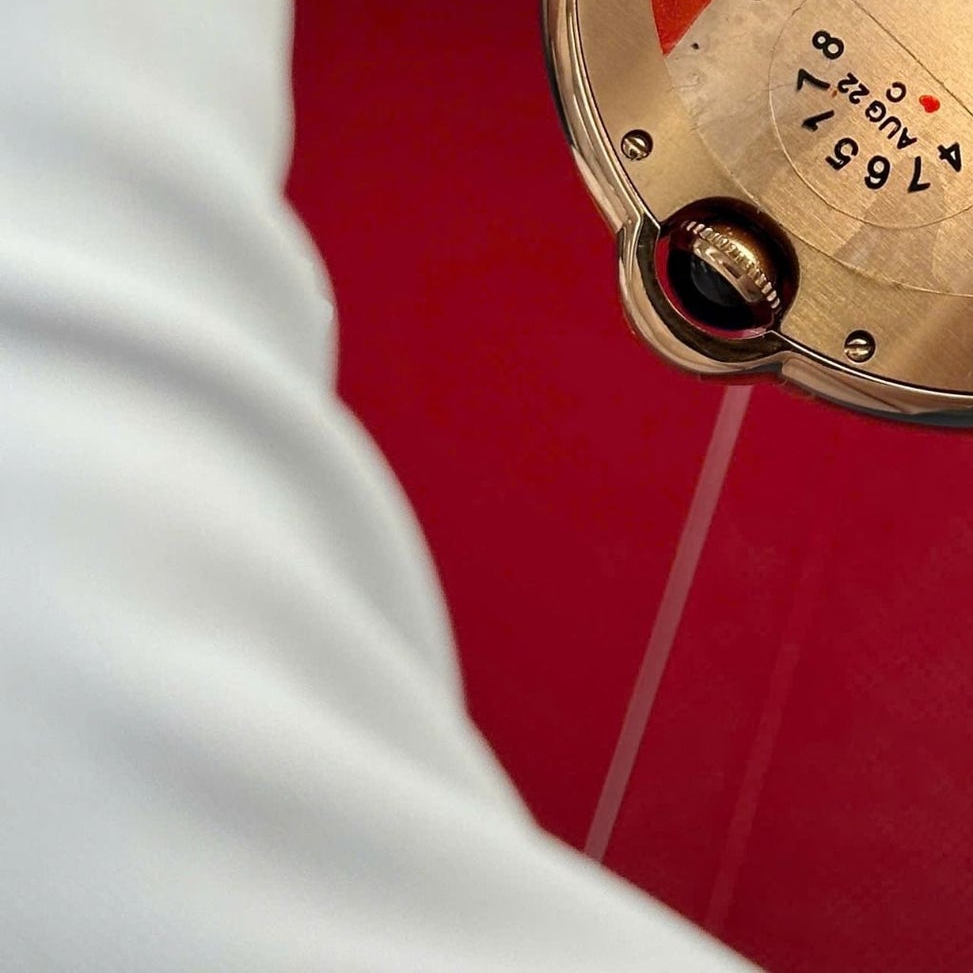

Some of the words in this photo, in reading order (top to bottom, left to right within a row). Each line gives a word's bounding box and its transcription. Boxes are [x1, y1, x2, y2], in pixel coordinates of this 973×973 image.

[837, 72, 870, 104] 22
[885, 81, 907, 103] C
[864, 99, 918, 149] AUG
